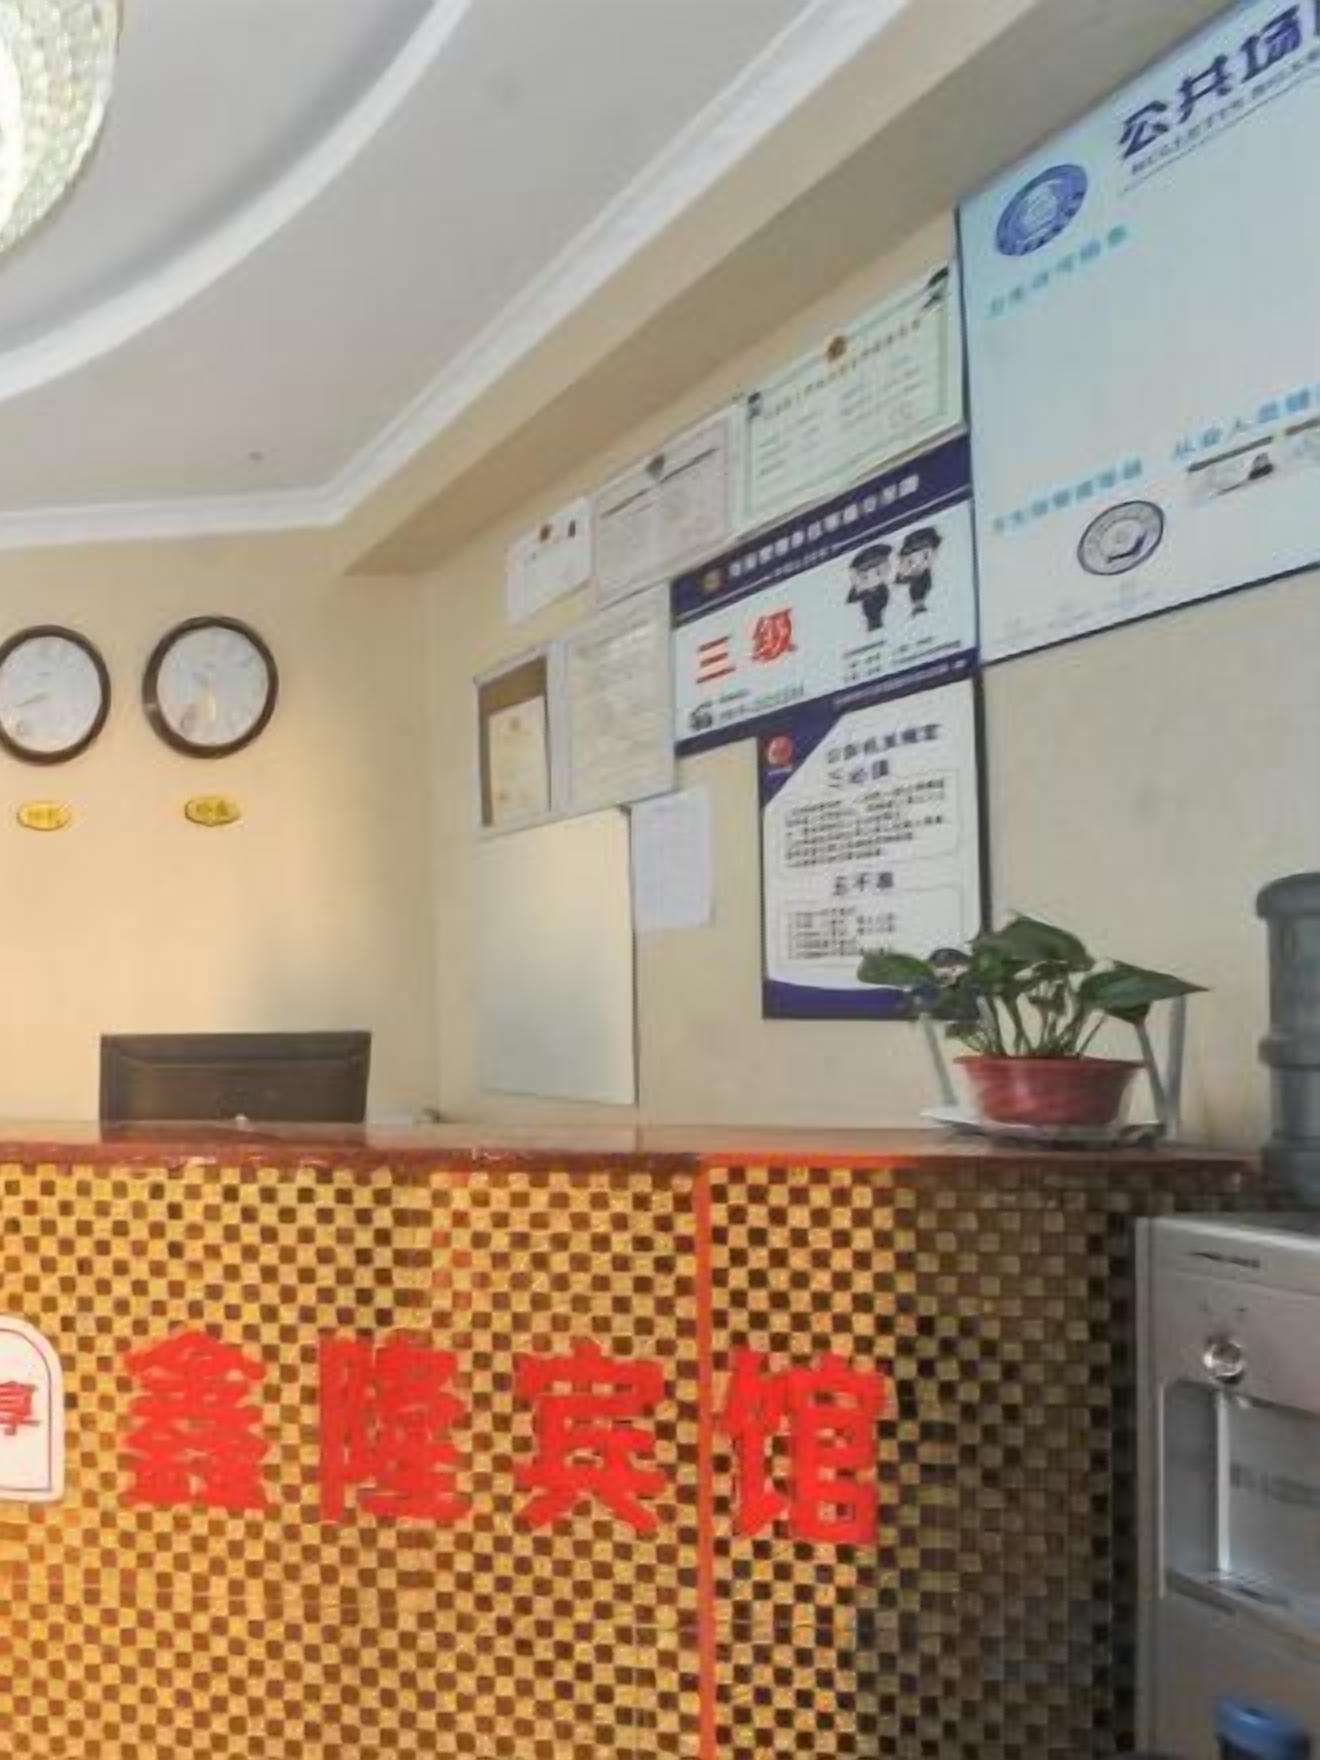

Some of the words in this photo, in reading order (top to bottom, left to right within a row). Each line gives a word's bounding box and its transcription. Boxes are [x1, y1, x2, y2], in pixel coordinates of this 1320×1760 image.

[1118, 0, 1320, 160] 公共场
[697, 608, 797, 684] 三级
[125, 1328, 890, 1545] 鑫隆宾馆
